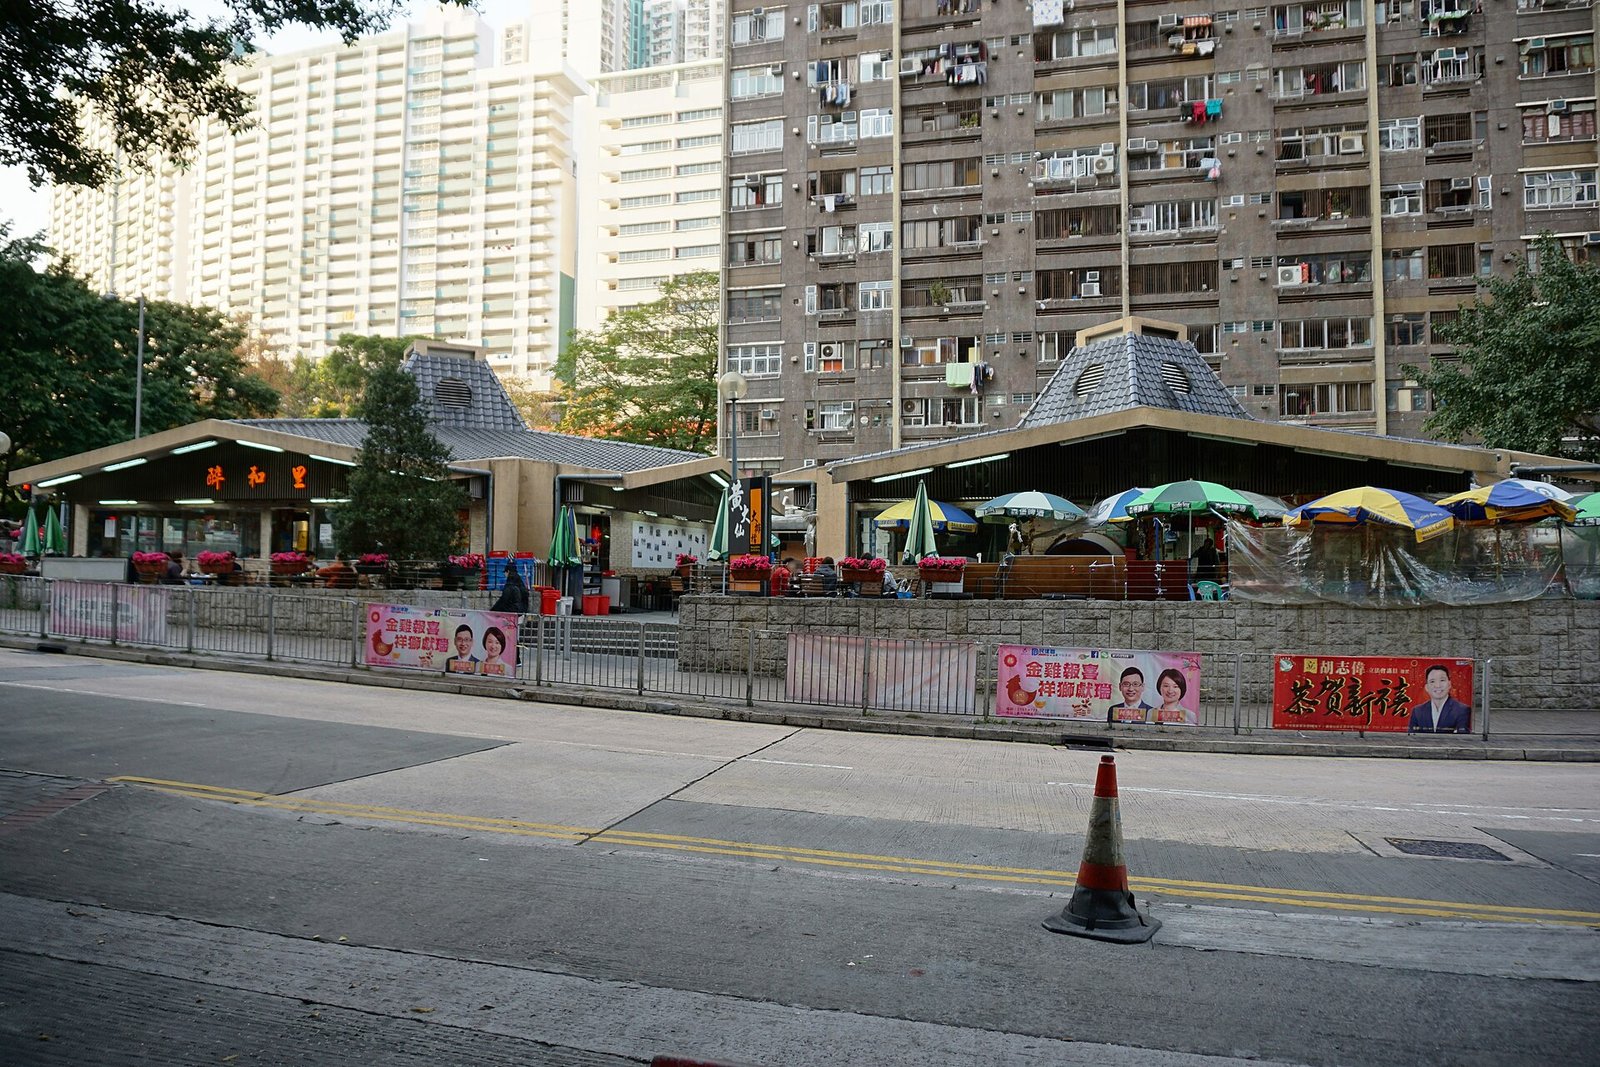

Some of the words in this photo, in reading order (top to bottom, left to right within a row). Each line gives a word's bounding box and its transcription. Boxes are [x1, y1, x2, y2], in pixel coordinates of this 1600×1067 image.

[728, 479, 750, 538] 黃大仙
[385, 617, 440, 636] 金雞報喜
[394, 635, 449, 653] 祥獅獻瑞
[1025, 661, 1099, 680] 金雞報喜
[1320, 660, 1366, 676] 胡志偉
[1037, 680, 1112, 700] 祥獅獻瑞
[1283, 675, 1413, 726] 恭賀新禧
